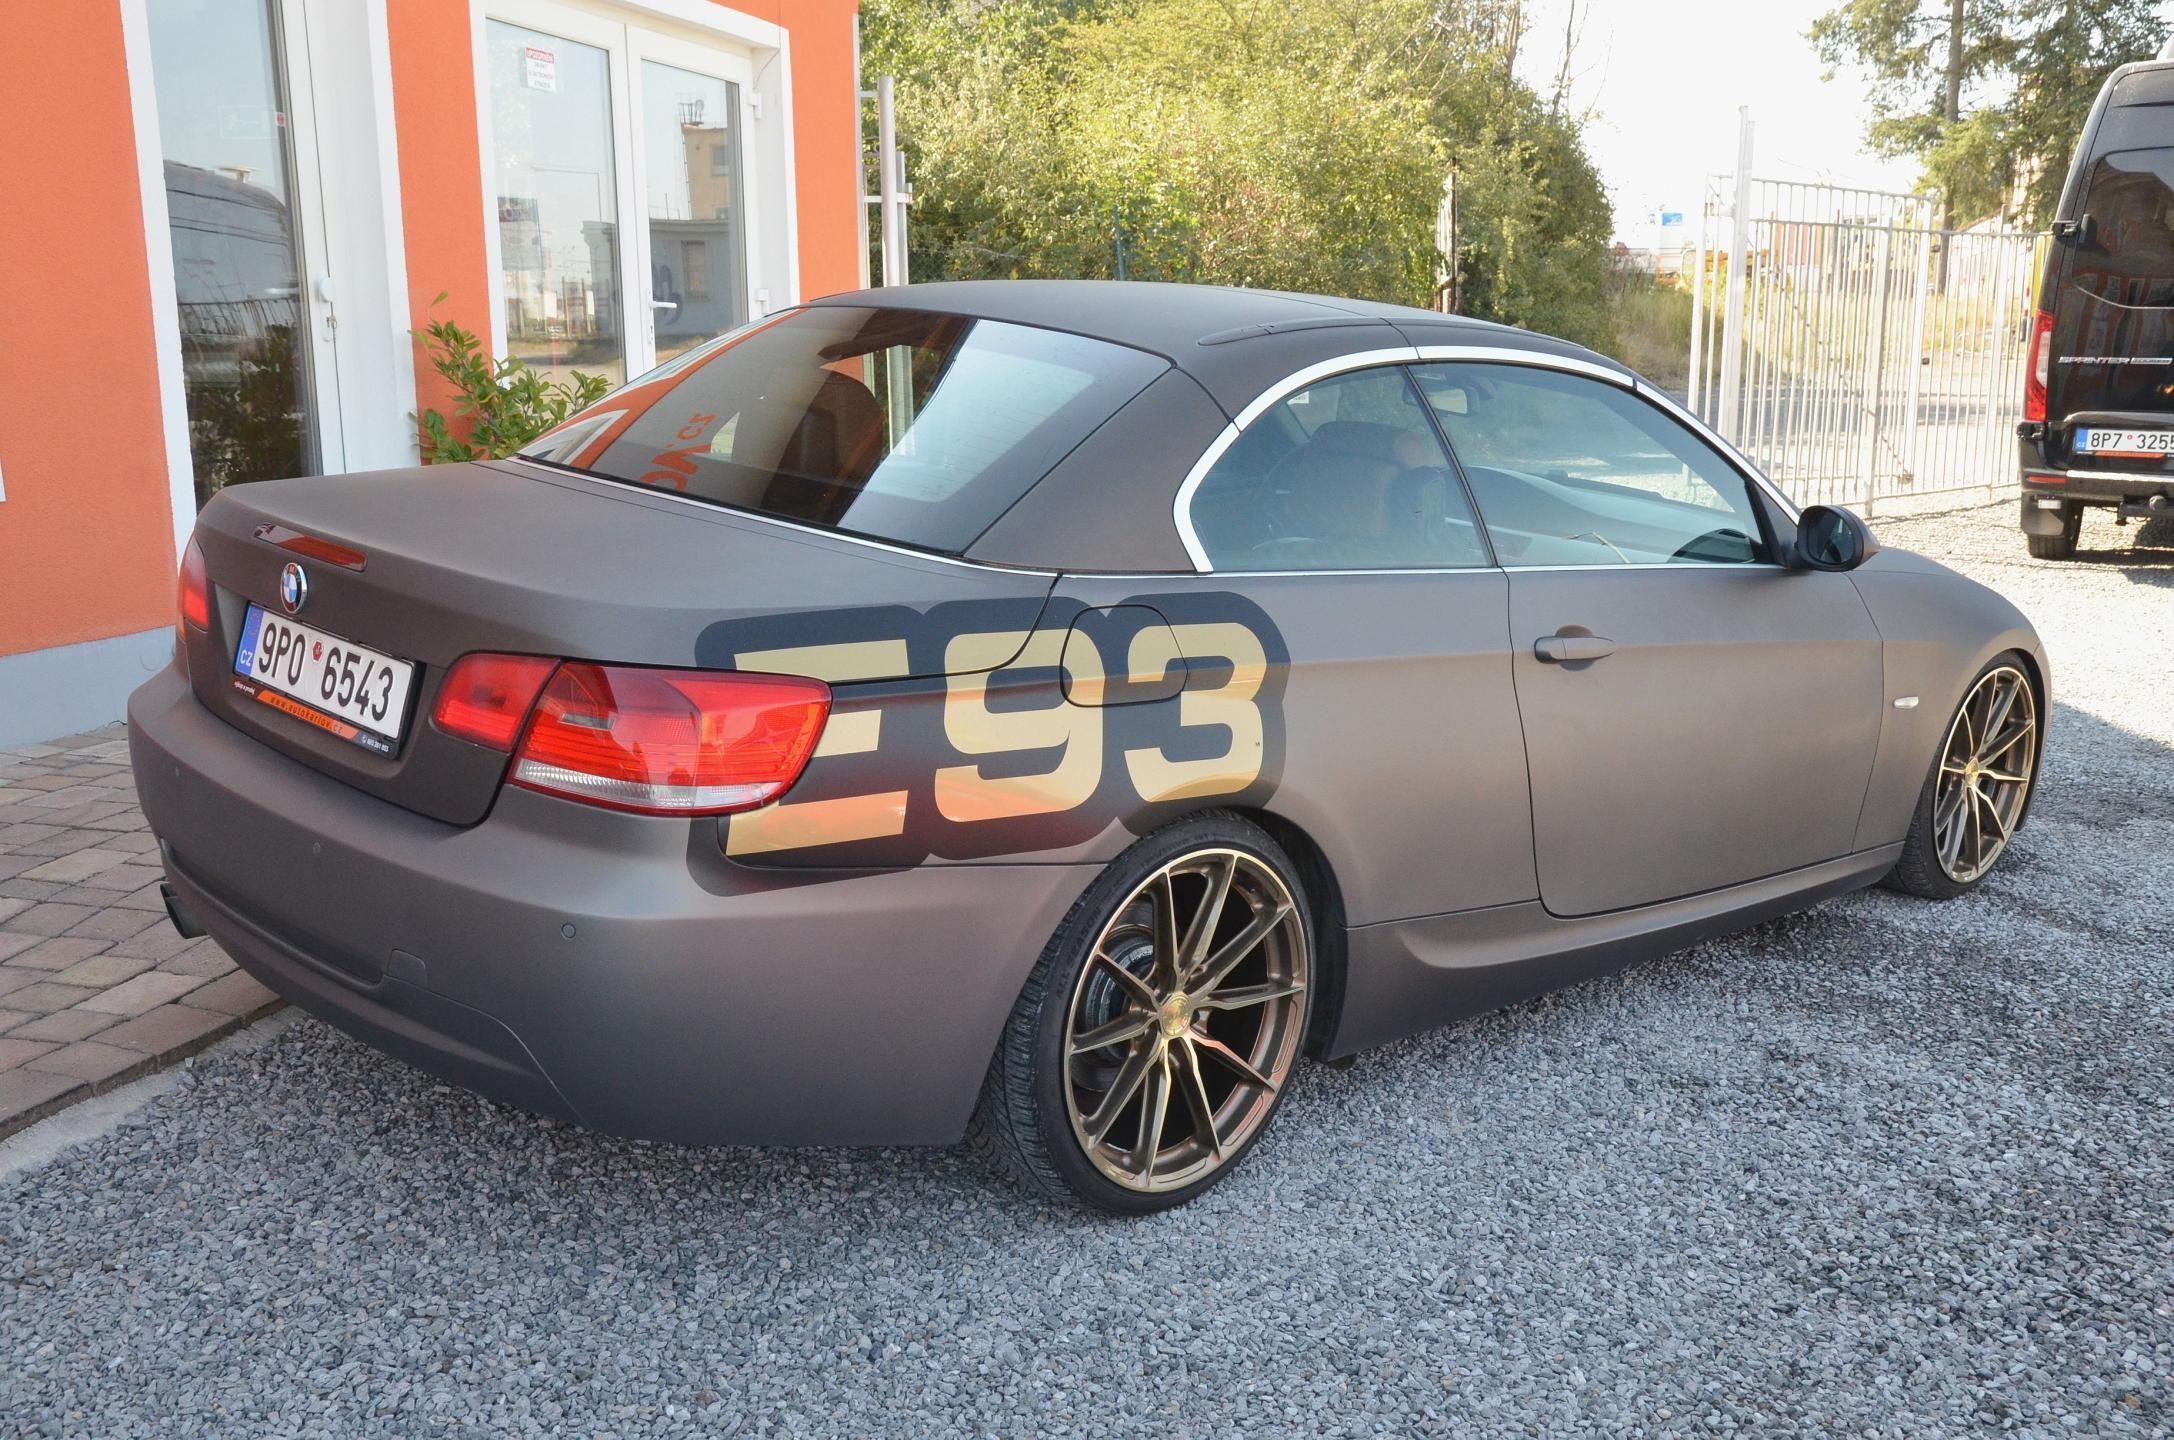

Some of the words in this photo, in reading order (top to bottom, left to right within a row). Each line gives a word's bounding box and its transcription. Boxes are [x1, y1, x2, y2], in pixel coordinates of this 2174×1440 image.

[2057, 356, 2130, 365] SPRINTER
[2090, 432, 2122, 448] 8P7
[240, 650, 253, 667] CZ
[259, 622, 306, 686] 9P0
[321, 647, 394, 722] 6543
[726, 622, 1267, 856] E93
